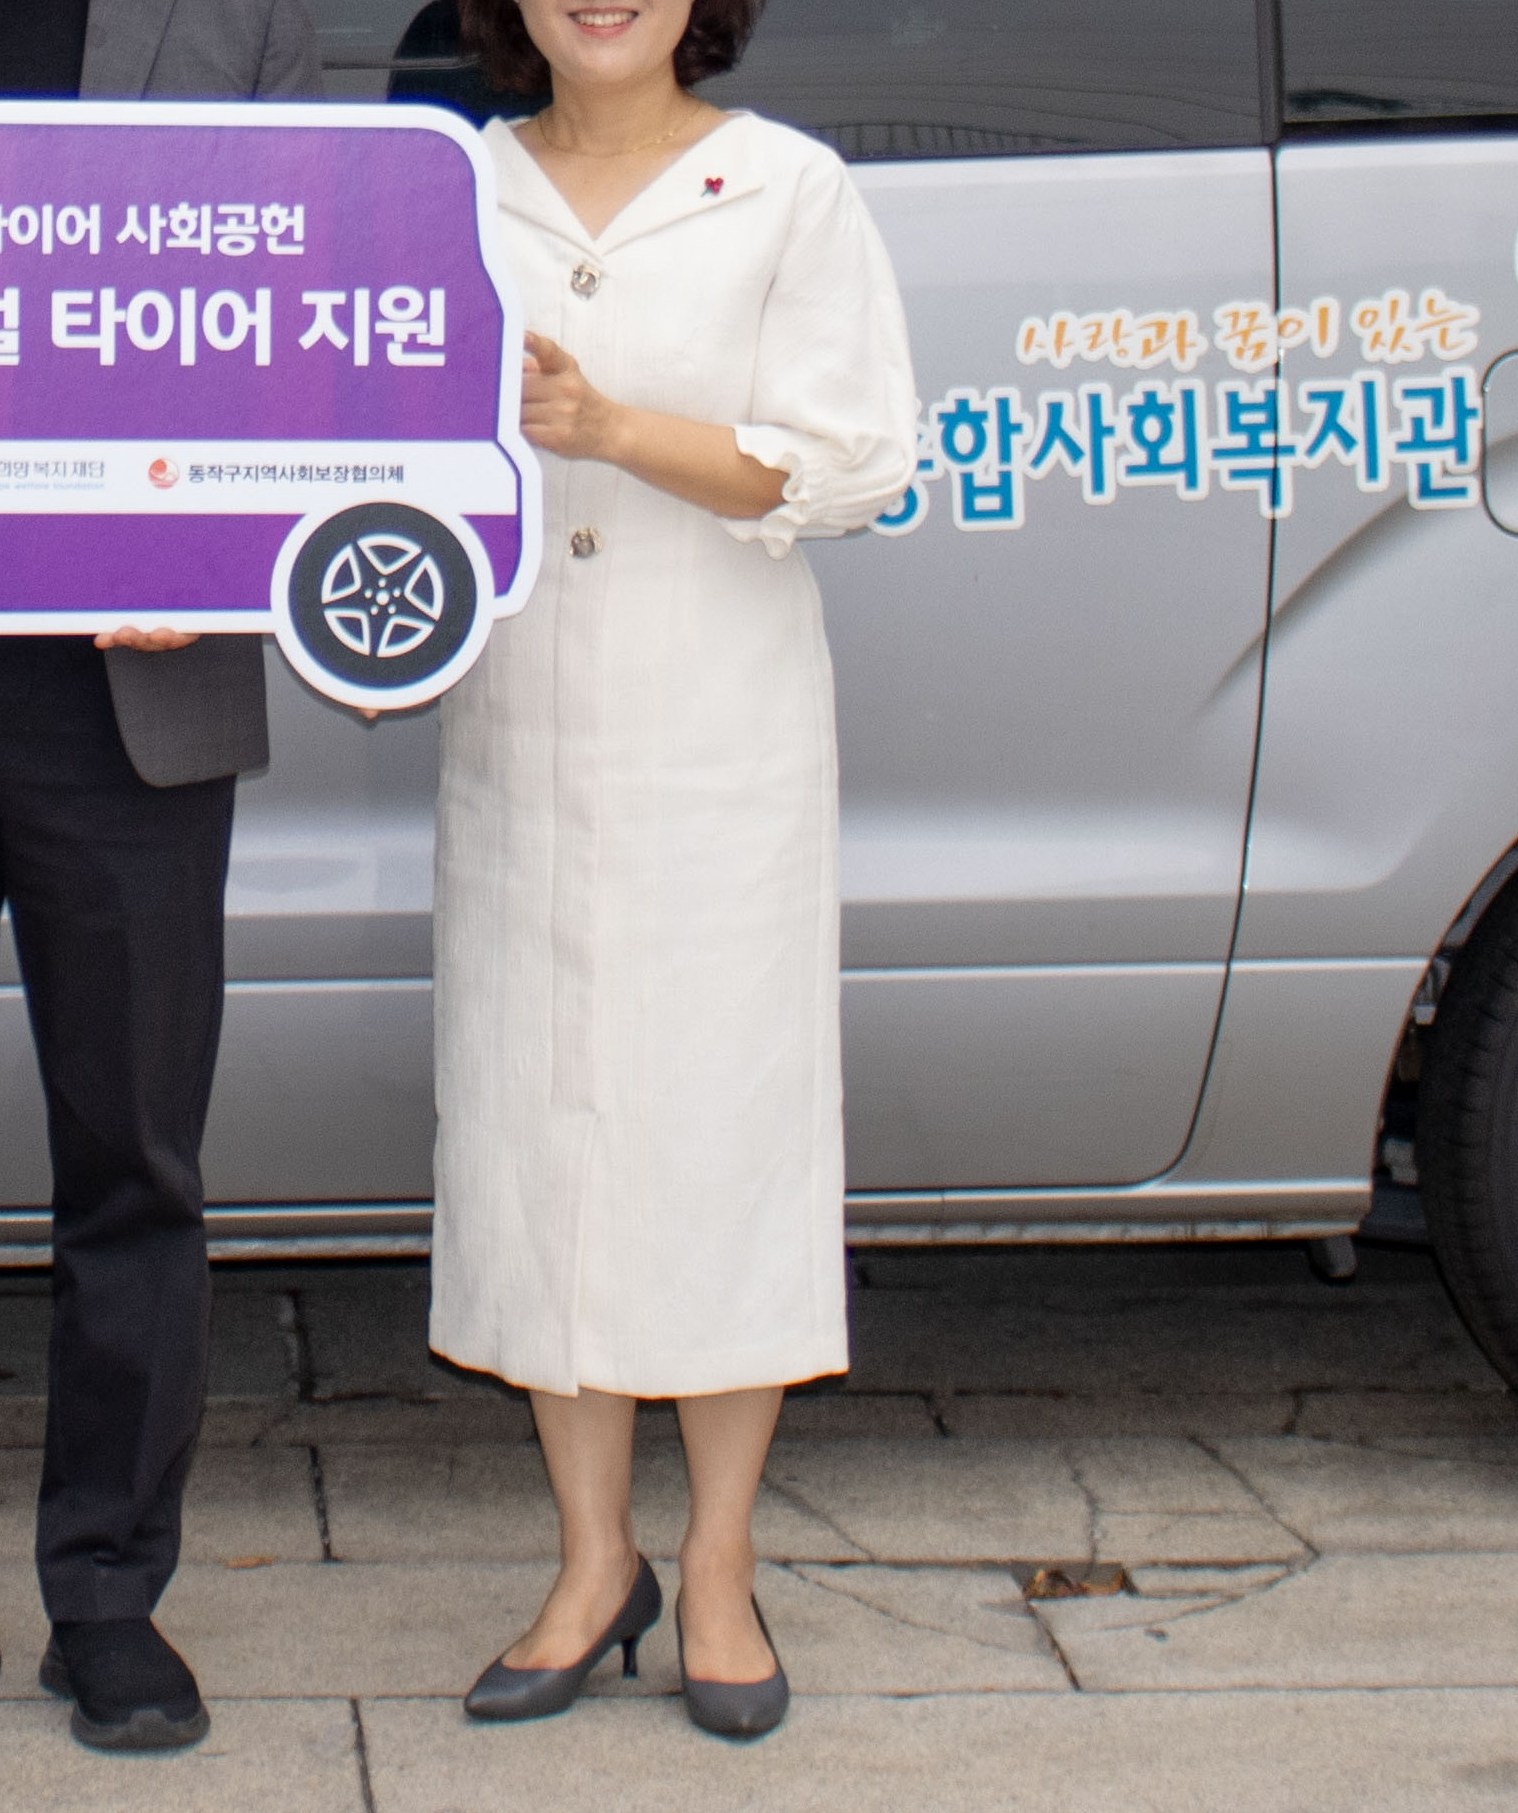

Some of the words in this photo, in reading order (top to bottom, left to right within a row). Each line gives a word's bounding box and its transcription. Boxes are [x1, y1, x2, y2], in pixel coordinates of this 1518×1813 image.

[115, 203, 307, 256] 사회공헌
[51, 283, 274, 368] 타이어
[299, 283, 449, 369] 지원
[1021, 311, 1198, 363] 사랑과
[1217, 299, 1331, 362] 꿈이
[1355, 296, 1469, 352] 있는
[187, 463, 405, 484] 동작구지역사회보장협의체
